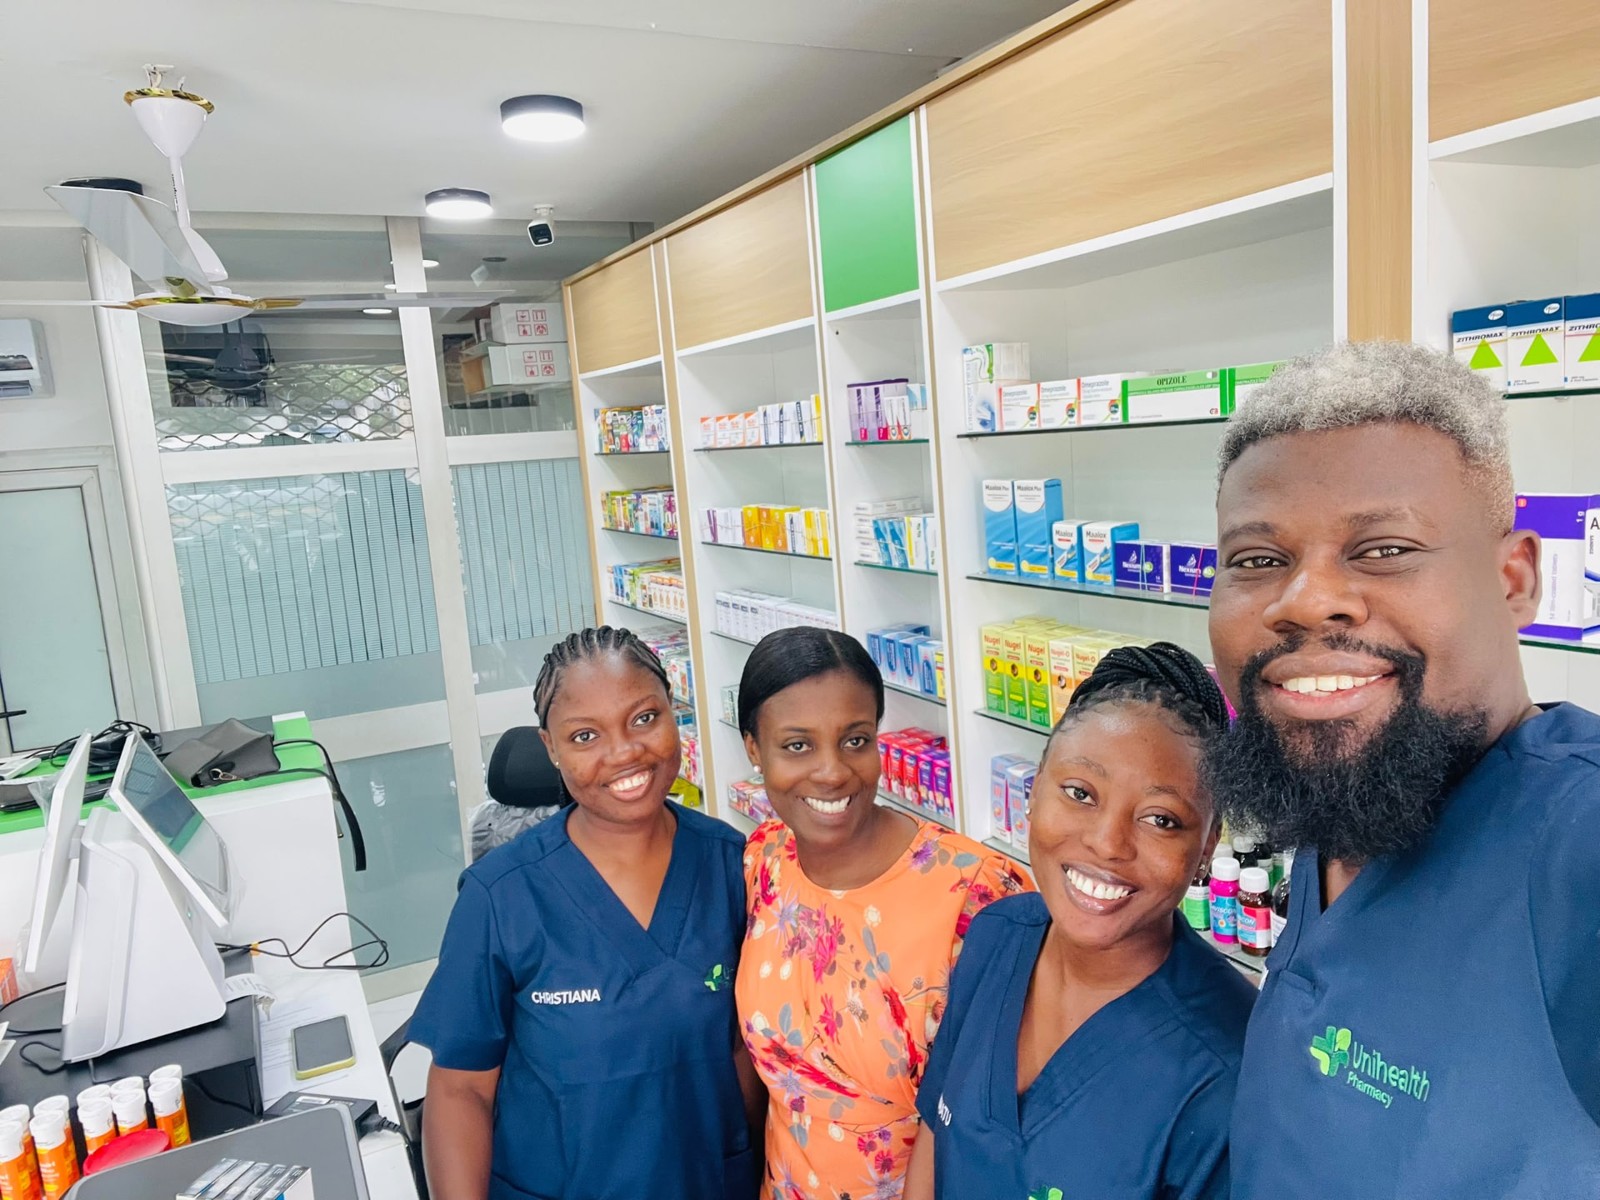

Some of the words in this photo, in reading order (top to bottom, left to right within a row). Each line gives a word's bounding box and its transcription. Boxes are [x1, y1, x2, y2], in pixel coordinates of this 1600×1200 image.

[1456, 331, 1504, 343] ZITHROMAX
[1510, 326, 1561, 338] ZITHROMAX
[1156, 375, 1188, 386] OPIZOLE
[985, 484, 1001, 492] Maalox
[1017, 484, 1034, 492] Maalox
[1590, 517, 1600, 530] A
[1055, 529, 1074, 538] Maalox
[1085, 530, 1107, 539] Maalox
[984, 635, 1001, 646] Nugel
[1004, 638, 1022, 650] Nugel
[1027, 643, 1045, 656] Nugel
[531, 988, 601, 1005] CHRISTIANA
[1352, 1041, 1430, 1102] Unihealth
[1346, 1070, 1394, 1109] Pharmacy
